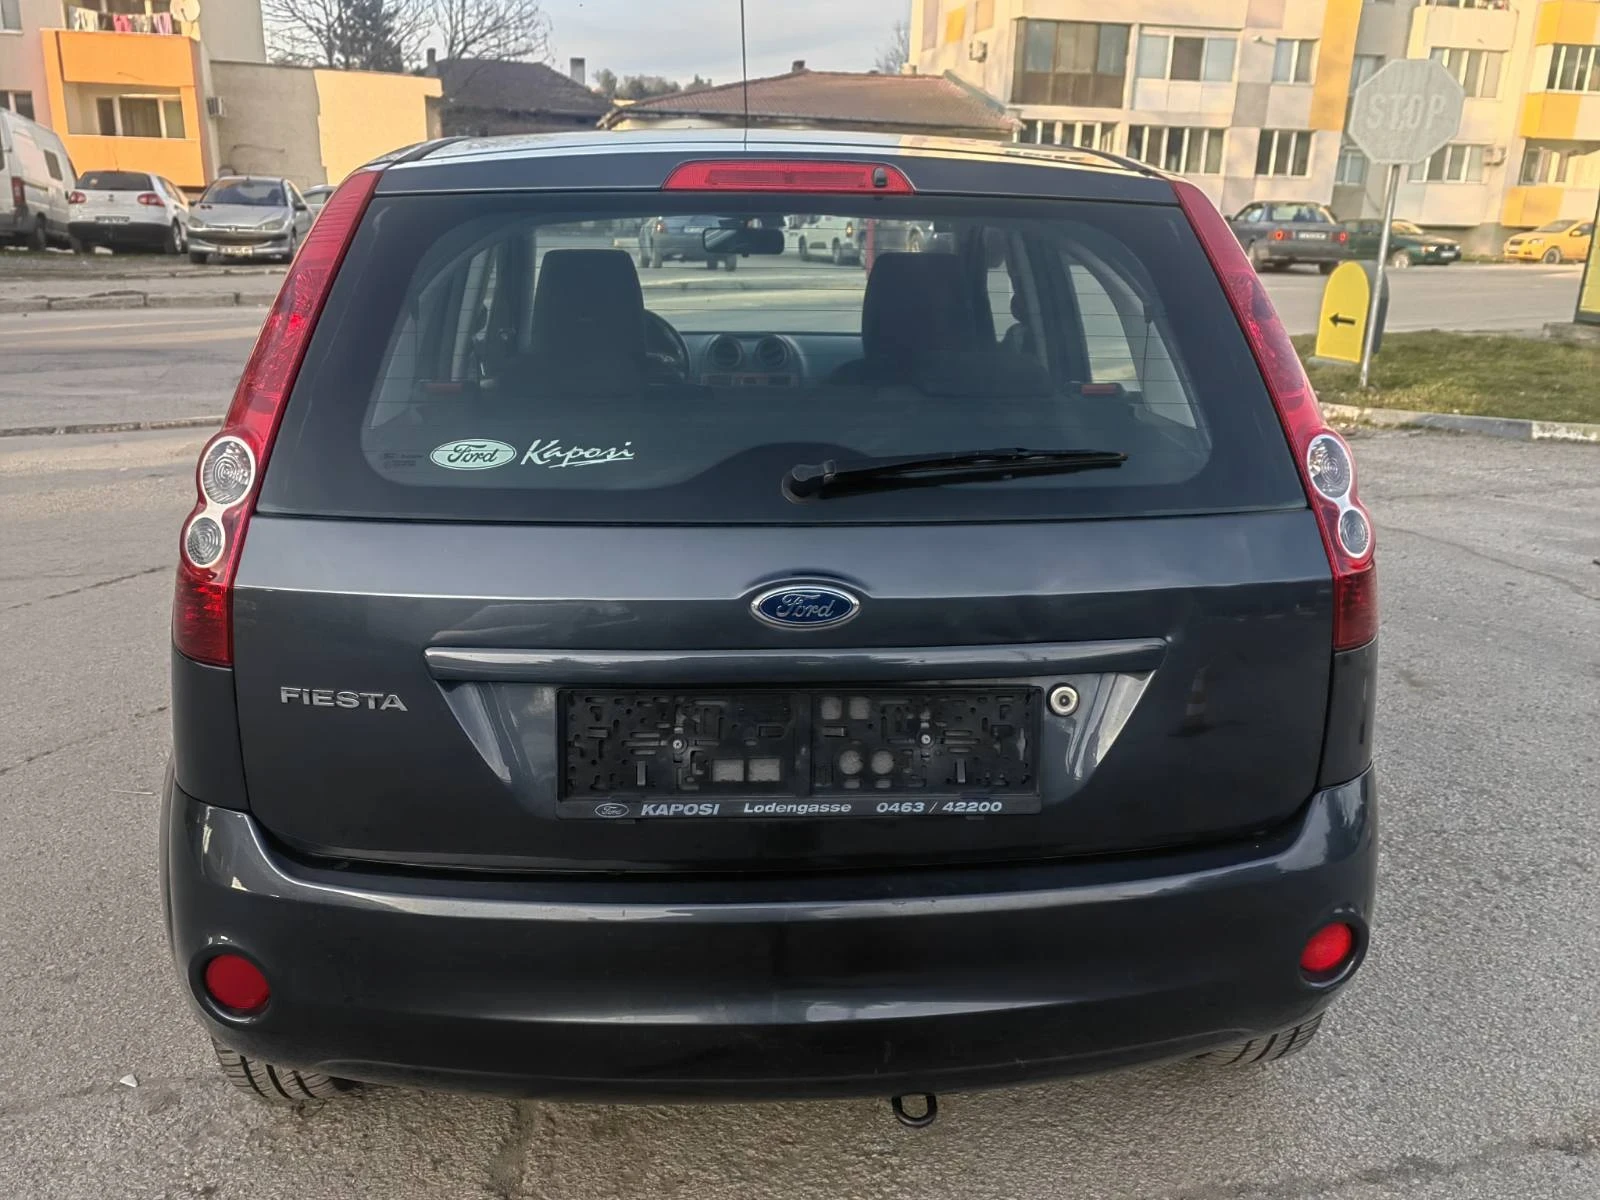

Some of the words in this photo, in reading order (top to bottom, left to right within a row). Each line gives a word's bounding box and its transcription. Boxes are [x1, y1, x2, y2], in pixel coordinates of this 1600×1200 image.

[1367, 93, 1445, 130] STOP
[520, 439, 635, 468] Kaposi
[775, 593, 836, 618] Ford
[280, 686, 408, 712] FIESTA
[641, 803, 720, 816] KAPOSI
[743, 802, 851, 815] Lodengasse
[876, 802, 925, 813] 0463
[942, 801, 1003, 812] 42200
